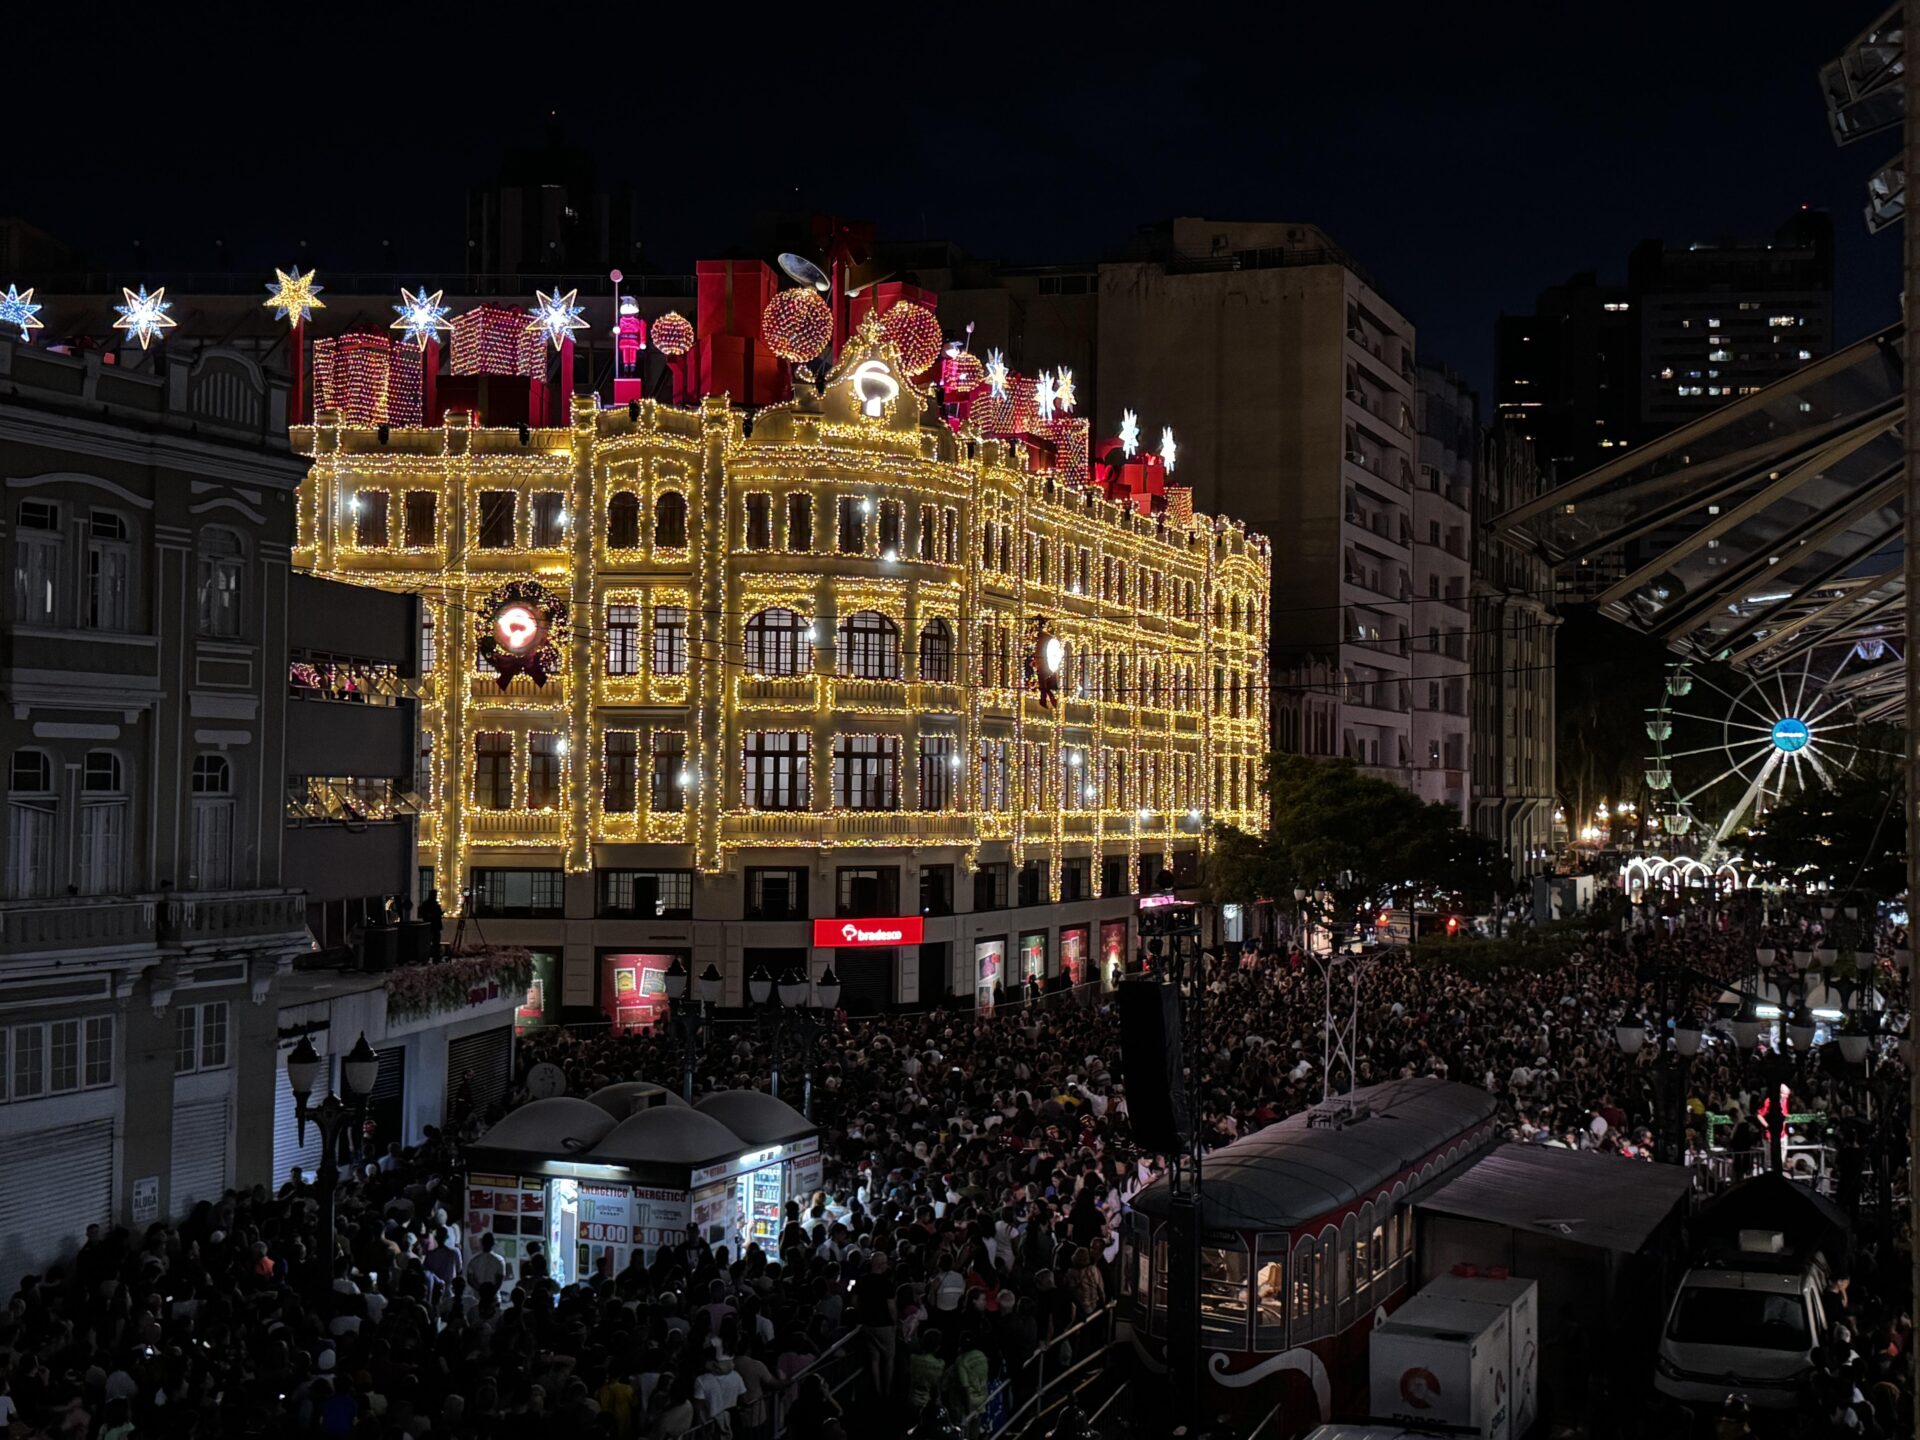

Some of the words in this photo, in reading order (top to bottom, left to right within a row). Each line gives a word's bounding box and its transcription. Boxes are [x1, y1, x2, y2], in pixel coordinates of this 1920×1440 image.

[857, 929, 902, 941] bradesco
[134, 1195, 157, 1209] ALUGA
[634, 1188, 687, 1202] ENERGÉTICO
